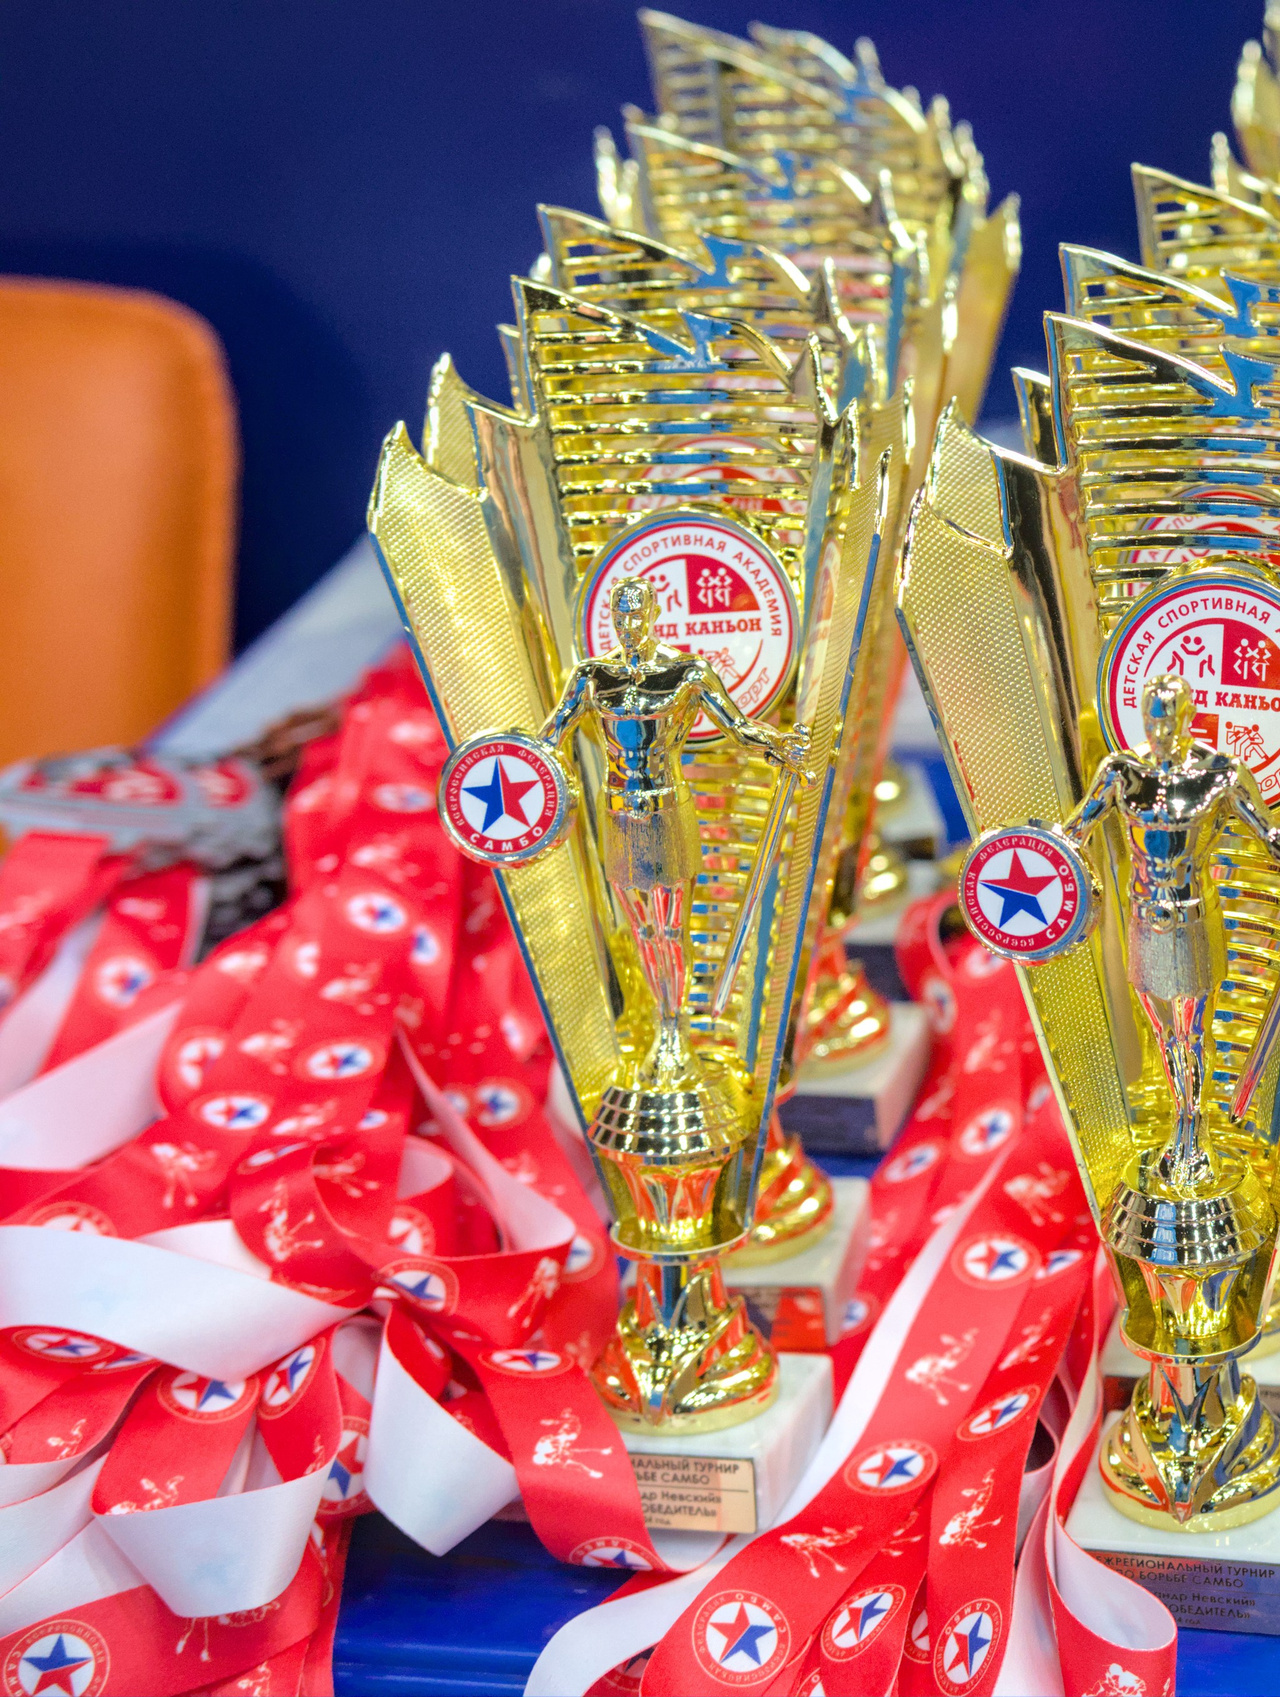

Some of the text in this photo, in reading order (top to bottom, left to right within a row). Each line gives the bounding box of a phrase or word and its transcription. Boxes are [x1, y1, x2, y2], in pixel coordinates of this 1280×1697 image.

[622, 534, 727, 572] СПОРТИВНАЯ
[733, 552, 782, 637] АКАДЕМИЯ
[685, 618, 762, 636] КАНЬОН
[1123, 631, 1155, 709] ДЕТСКАЯ
[1157, 597, 1271, 629] СПОРТИВНАЯ
[470, 827, 543, 851] САМБО
[979, 837, 1054, 862] ФЕДЕРАЦИЯ
[1046, 865, 1075, 939] САМБО
[661, 1473, 710, 1485] САМБО
[694, 1461, 739, 1474] ТУРНИР
[641, 1503, 717, 1517] ОБЕДИТЕЛЬ»
[1096, 1556, 1275, 1579] ЕЖРЕГИОНАЛЬНЫЙ ТУРНИР
[1139, 1571, 1187, 1583] БОРЬБЕ
[1192, 1575, 1243, 1588] САМБО
[1167, 1603, 1251, 1619] ОБЕДИТЕЛЬ»
[1192, 1592, 1256, 1607] Невский»
[735, 1593, 786, 1633] САМБО
[945, 1602, 990, 1635] САМБО
